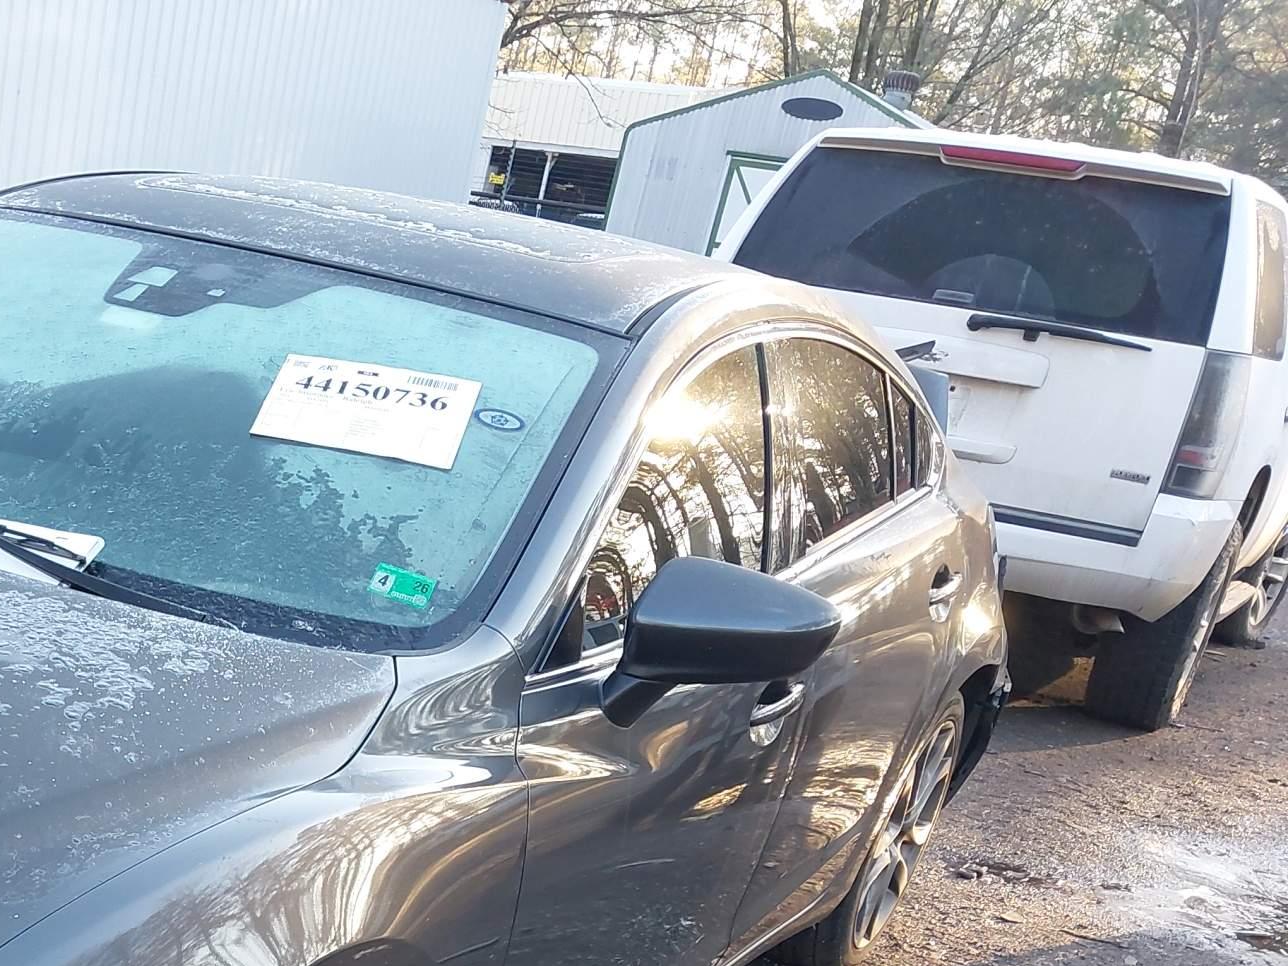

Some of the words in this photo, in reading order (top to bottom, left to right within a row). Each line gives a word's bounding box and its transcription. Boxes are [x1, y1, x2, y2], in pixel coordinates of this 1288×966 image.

[295, 375, 449, 411] 44150736
[378, 575, 389, 586] 4
[413, 581, 430, 593] 26
